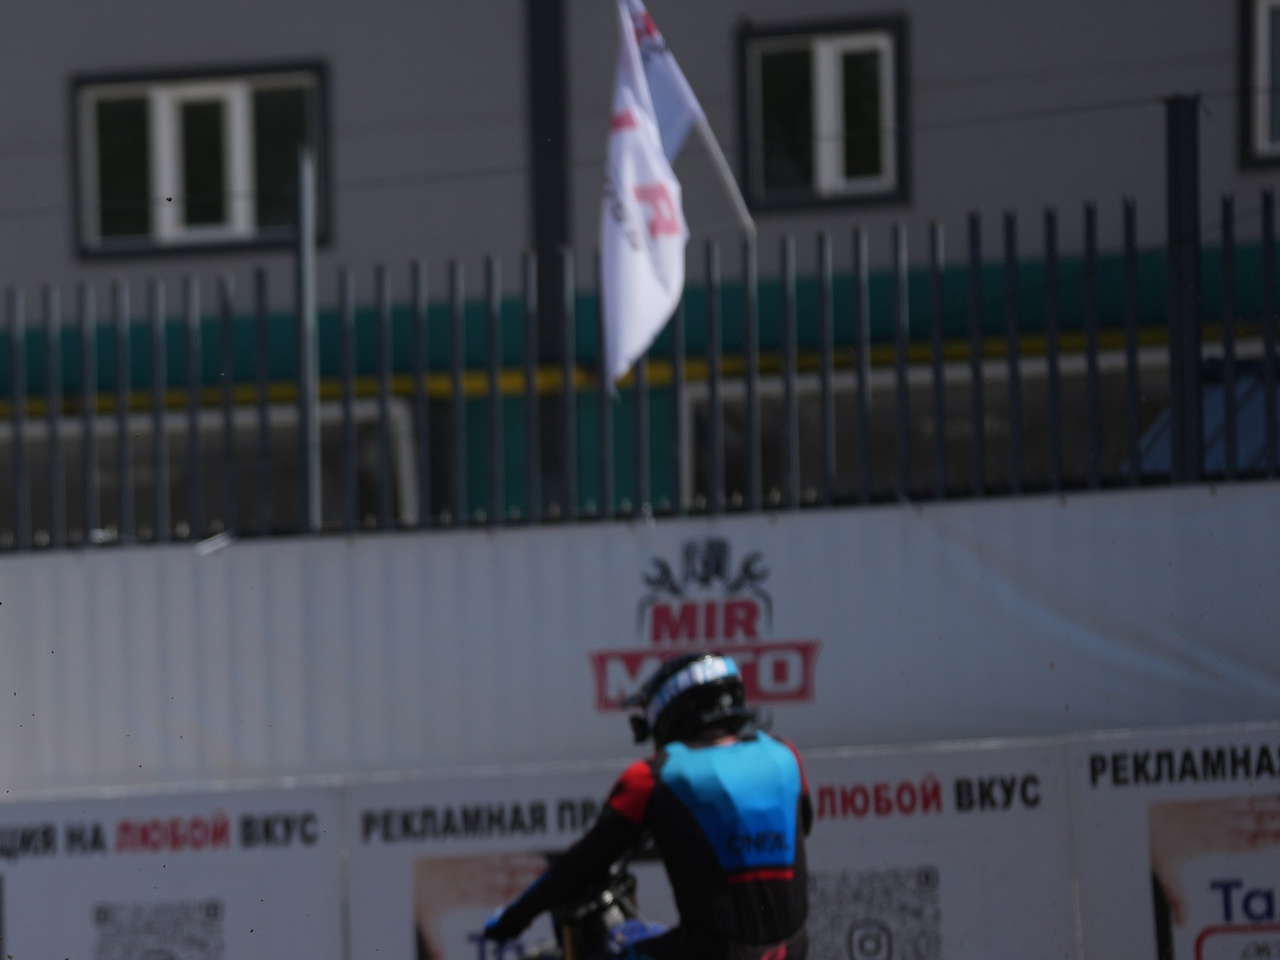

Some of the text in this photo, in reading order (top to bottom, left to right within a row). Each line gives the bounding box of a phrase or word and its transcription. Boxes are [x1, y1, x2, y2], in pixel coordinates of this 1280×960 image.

[651, 599, 760, 643] MIR
[1089, 741, 1280, 788] РЕКЛАМНА
[816, 773, 1042, 819] ЛЮБОЙ ВКУС
[65, 820, 107, 856] НА
[114, 806, 231, 857] ЛЮБОЙ
[238, 812, 319, 850] ВКУС
[361, 799, 548, 843] РЕКЛАМНАЯ
